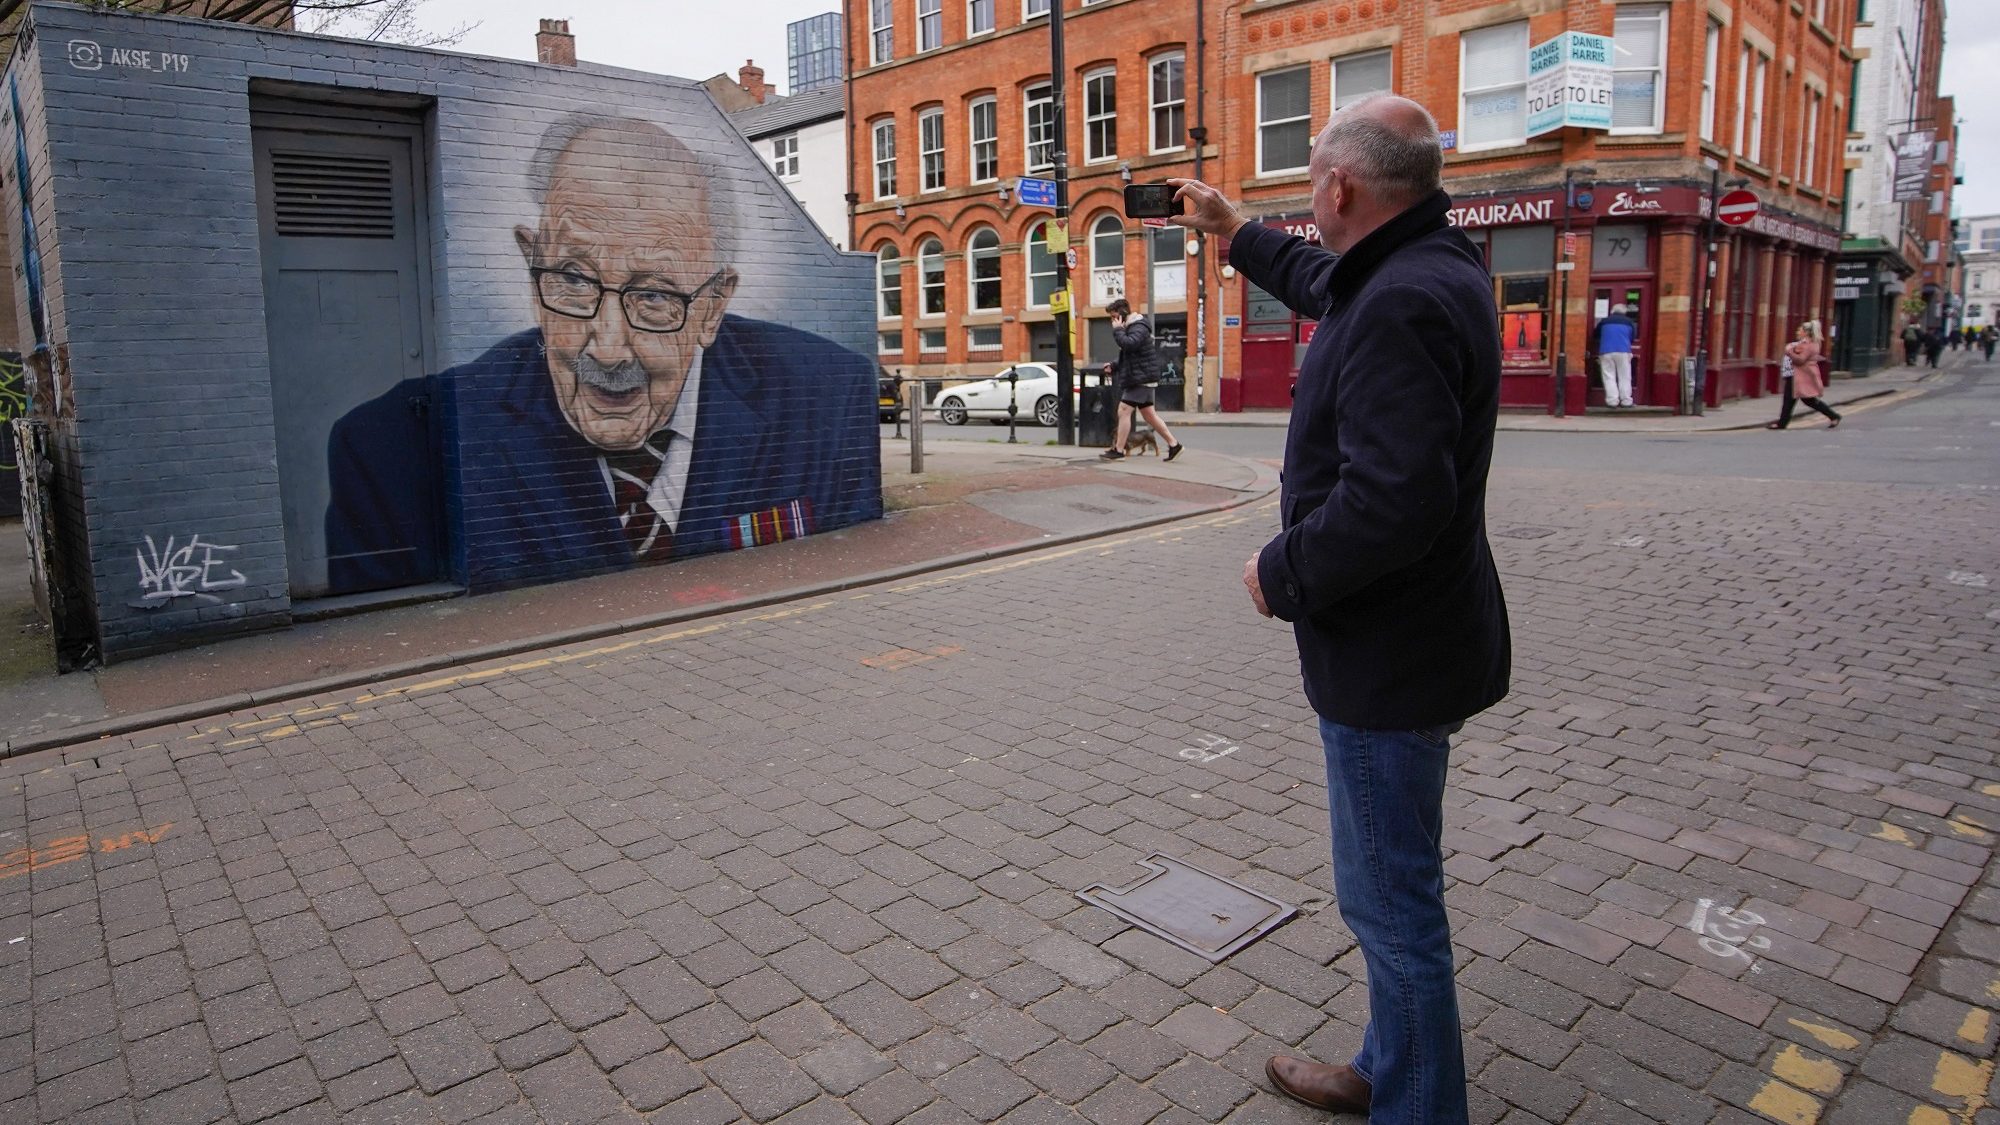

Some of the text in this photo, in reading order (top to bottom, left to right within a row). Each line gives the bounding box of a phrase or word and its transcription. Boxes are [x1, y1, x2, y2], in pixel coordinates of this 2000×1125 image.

[1531, 41, 1560, 61] DANIEL
[1573, 35, 1605, 50] DANIEL
[111, 48, 189, 72] AKSE_P19
[1531, 53, 1560, 74] HARRIS
[1572, 48, 1605, 62] HARRIS
[1528, 97, 1544, 114] TO
[1547, 86, 1565, 108] LET
[1568, 86, 1586, 103] TO
[1591, 88, 1613, 105] LET
[1445, 199, 1554, 227] STAURANT
[1285, 223, 1320, 241] TAPA
[1608, 237, 1632, 257] 79
